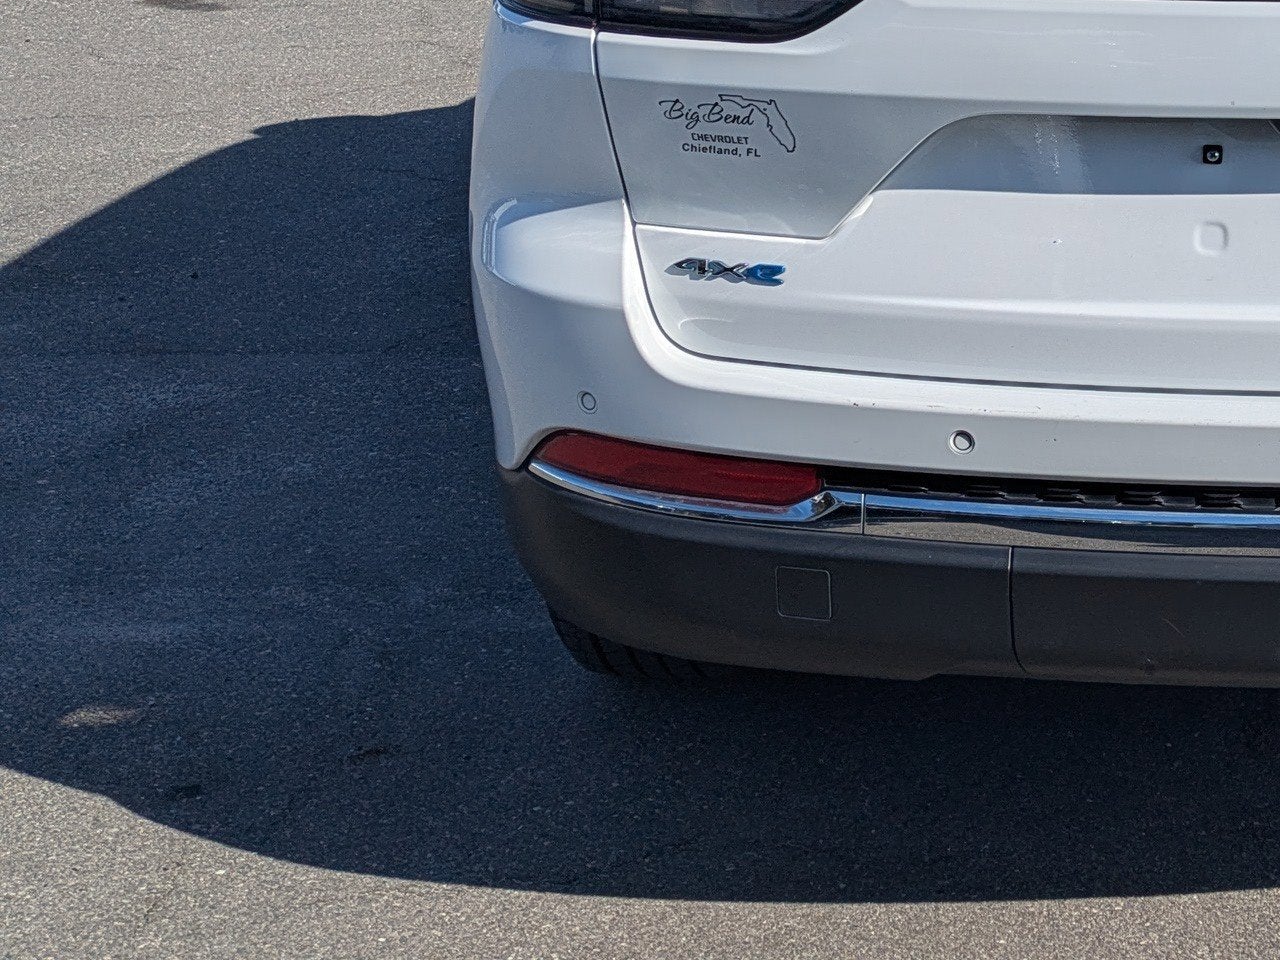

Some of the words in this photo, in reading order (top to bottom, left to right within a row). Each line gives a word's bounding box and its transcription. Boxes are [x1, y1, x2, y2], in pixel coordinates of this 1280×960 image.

[658, 98, 702, 130] Big
[697, 101, 755, 127] Bend
[691, 132, 750, 145] CHEVROLET
[681, 142, 743, 158] Chiefland,
[746, 147, 762, 158] FL
